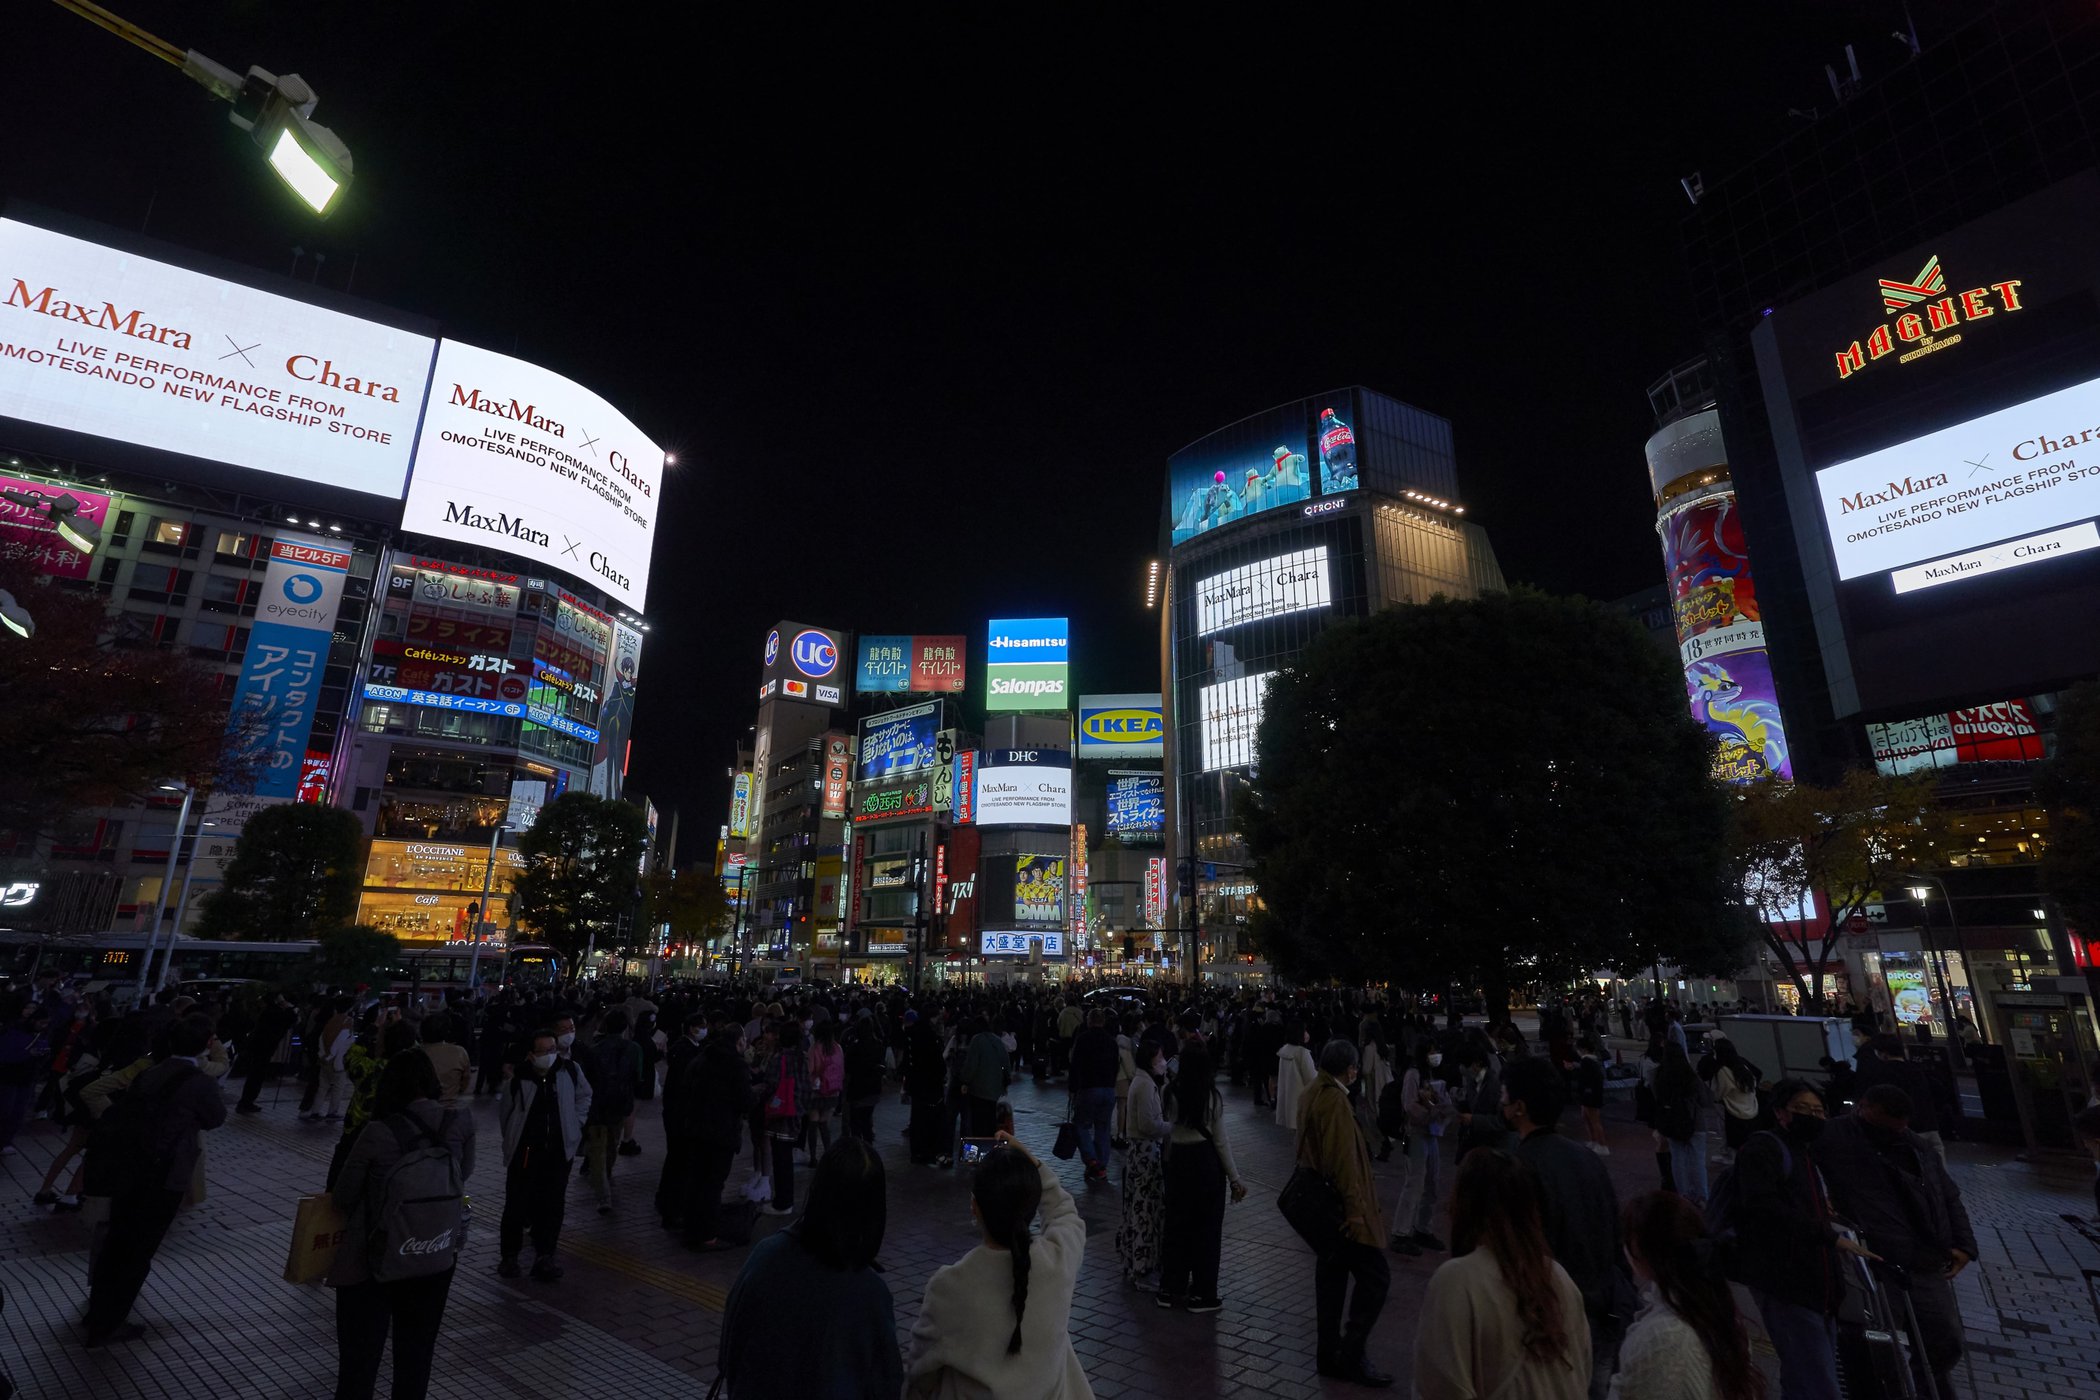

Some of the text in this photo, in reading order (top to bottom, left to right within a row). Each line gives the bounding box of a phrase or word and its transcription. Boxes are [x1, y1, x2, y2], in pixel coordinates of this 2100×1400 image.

[6, 278, 400, 403] MaxMara Chara
[1836, 280, 2022, 379] MAGNET
[1900, 334, 1962, 364] SHIBUYA109
[57, 338, 345, 419] LIVE PERFORMANCE FROM
[163, 381, 215, 402] NEW
[221, 396, 322, 428] FLAGSHIP
[328, 421, 392, 446] STORE
[448, 383, 651, 498] MaxMara Chara
[484, 427, 632, 504] LIVE PERFORMANCE FROM
[440, 430, 648, 529] OMOTESANDO NEW FLAGSHIP STORE
[1839, 473, 1948, 516] MaxMara
[1878, 460, 2076, 524] LIVE PERFORMANCE FROM
[1304, 500, 1345, 517] QFRONT
[1847, 466, 2100, 543] OMOTESANDO NEW FLAGSHIP STO
[279, 545, 342, 565] 当ビル5F
[442, 501, 630, 591] MaxMara Chara
[1925, 540, 2062, 580] MaxMara Chara
[392, 577, 413, 588] 9F
[1205, 570, 1320, 608] MaxMara Chara
[452, 584, 512, 608] しゃぶ葉
[266, 604, 328, 624] eyecity
[575, 614, 608, 645] しゃぶ葉
[766, 638, 778, 658] UC
[797, 640, 834, 667] UC
[869, 647, 902, 661] 龍角散
[923, 647, 956, 661] 龍角散
[989, 636, 1067, 648] Hisamitsu
[372, 664, 397, 680] 7F
[468, 654, 516, 674] ガスト
[431, 672, 492, 696] ガスト
[503, 686, 523, 694] ガスト
[573, 683, 598, 703] ガスト
[818, 689, 839, 700] VISA
[990, 678, 1065, 697] Salonpas
[270, 649, 317, 770] コンタクトの
[368, 686, 520, 715] AEON 英会話イーオン 6F
[530, 709, 599, 740] AEON 英会話イーオン
[863, 719, 911, 750] 日本サッカーに
[1091, 717, 1163, 732] IKEA
[861, 731, 915, 766] 足りないのは、
[884, 741, 935, 775] エゴだ。
[1009, 751, 1038, 762] DHC
[981, 782, 1067, 794] MaxMara Chara
[1116, 777, 1160, 791] 世界一の
[227, 801, 268, 811] CONTAC
[880, 796, 902, 811] 西村
[1108, 806, 1166, 825] ストライカー
[1116, 797, 1160, 812] 世界一の
[406, 844, 465, 856] L'OCCITANE
[0, 882, 40, 906] グ
[415, 895, 439, 905] Café
[949, 873, 976, 915] クスリ
[1015, 904, 1061, 921] DMM
[400, 1228, 453, 1256] Coca-Cola
